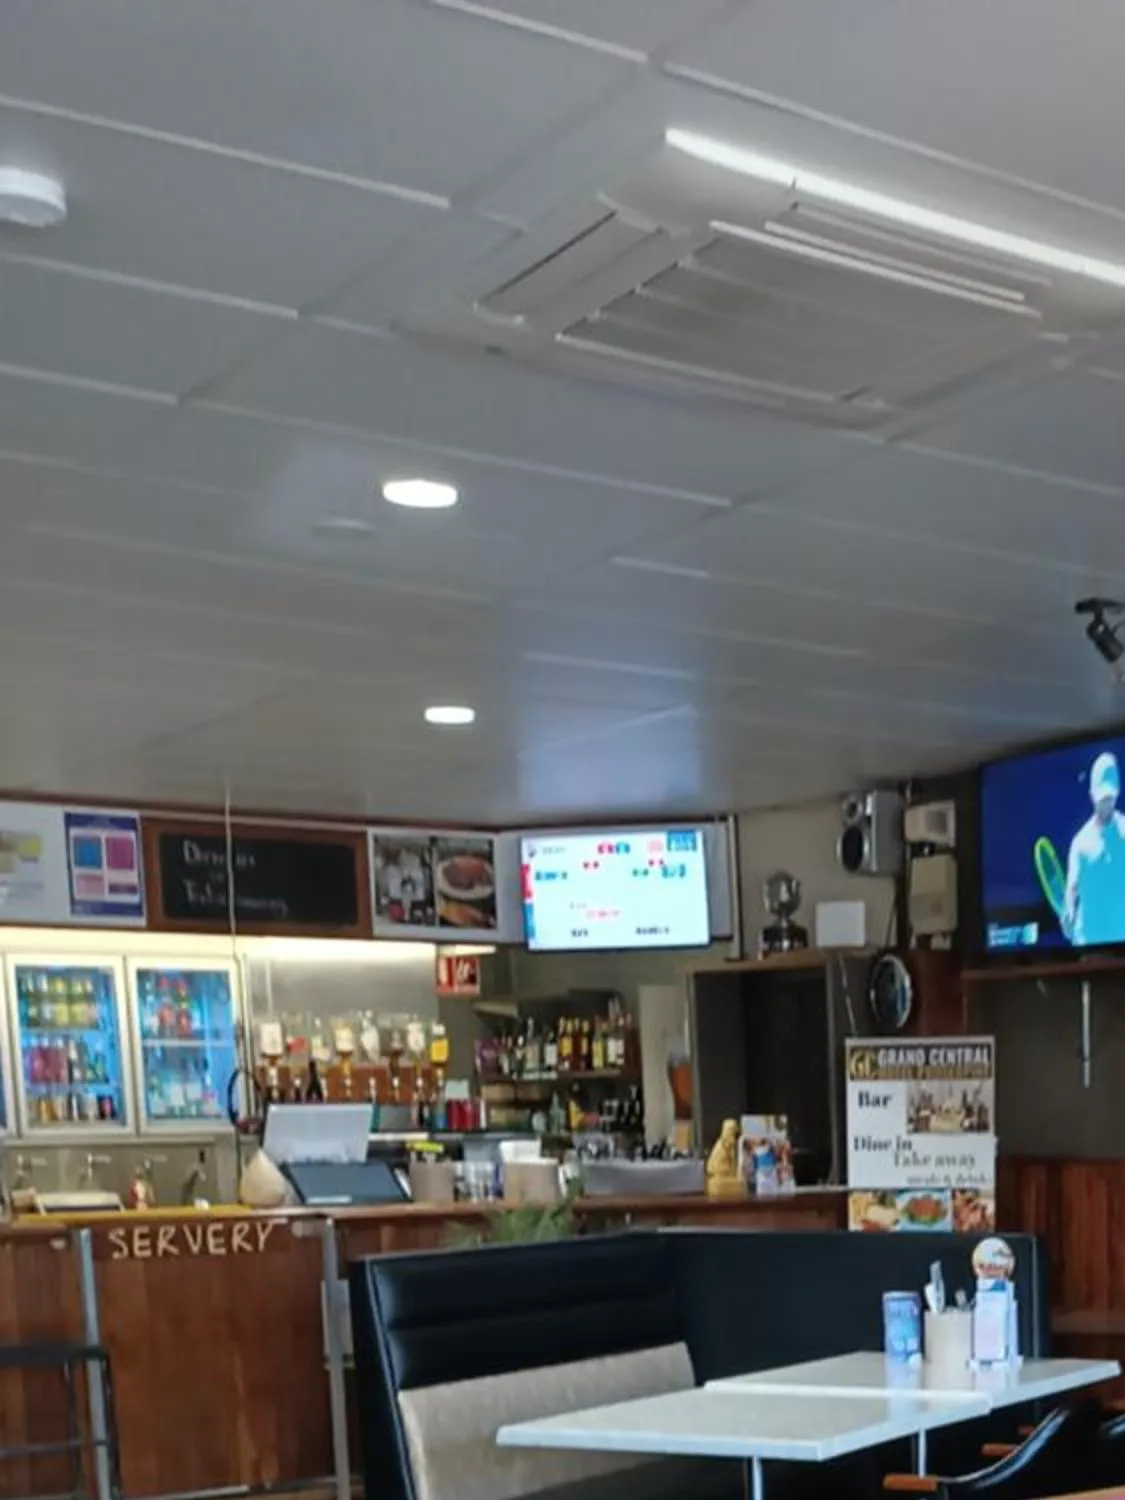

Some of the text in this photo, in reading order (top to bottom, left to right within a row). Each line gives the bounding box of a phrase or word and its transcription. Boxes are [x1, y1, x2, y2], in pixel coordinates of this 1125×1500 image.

[877, 1045, 990, 1066] GRAND CENTRAL
[857, 1090, 893, 1109] Bar
[853, 1136, 913, 1152] Dine in
[894, 1151, 976, 1171] Take away
[107, 1217, 288, 1260] SERVERY
